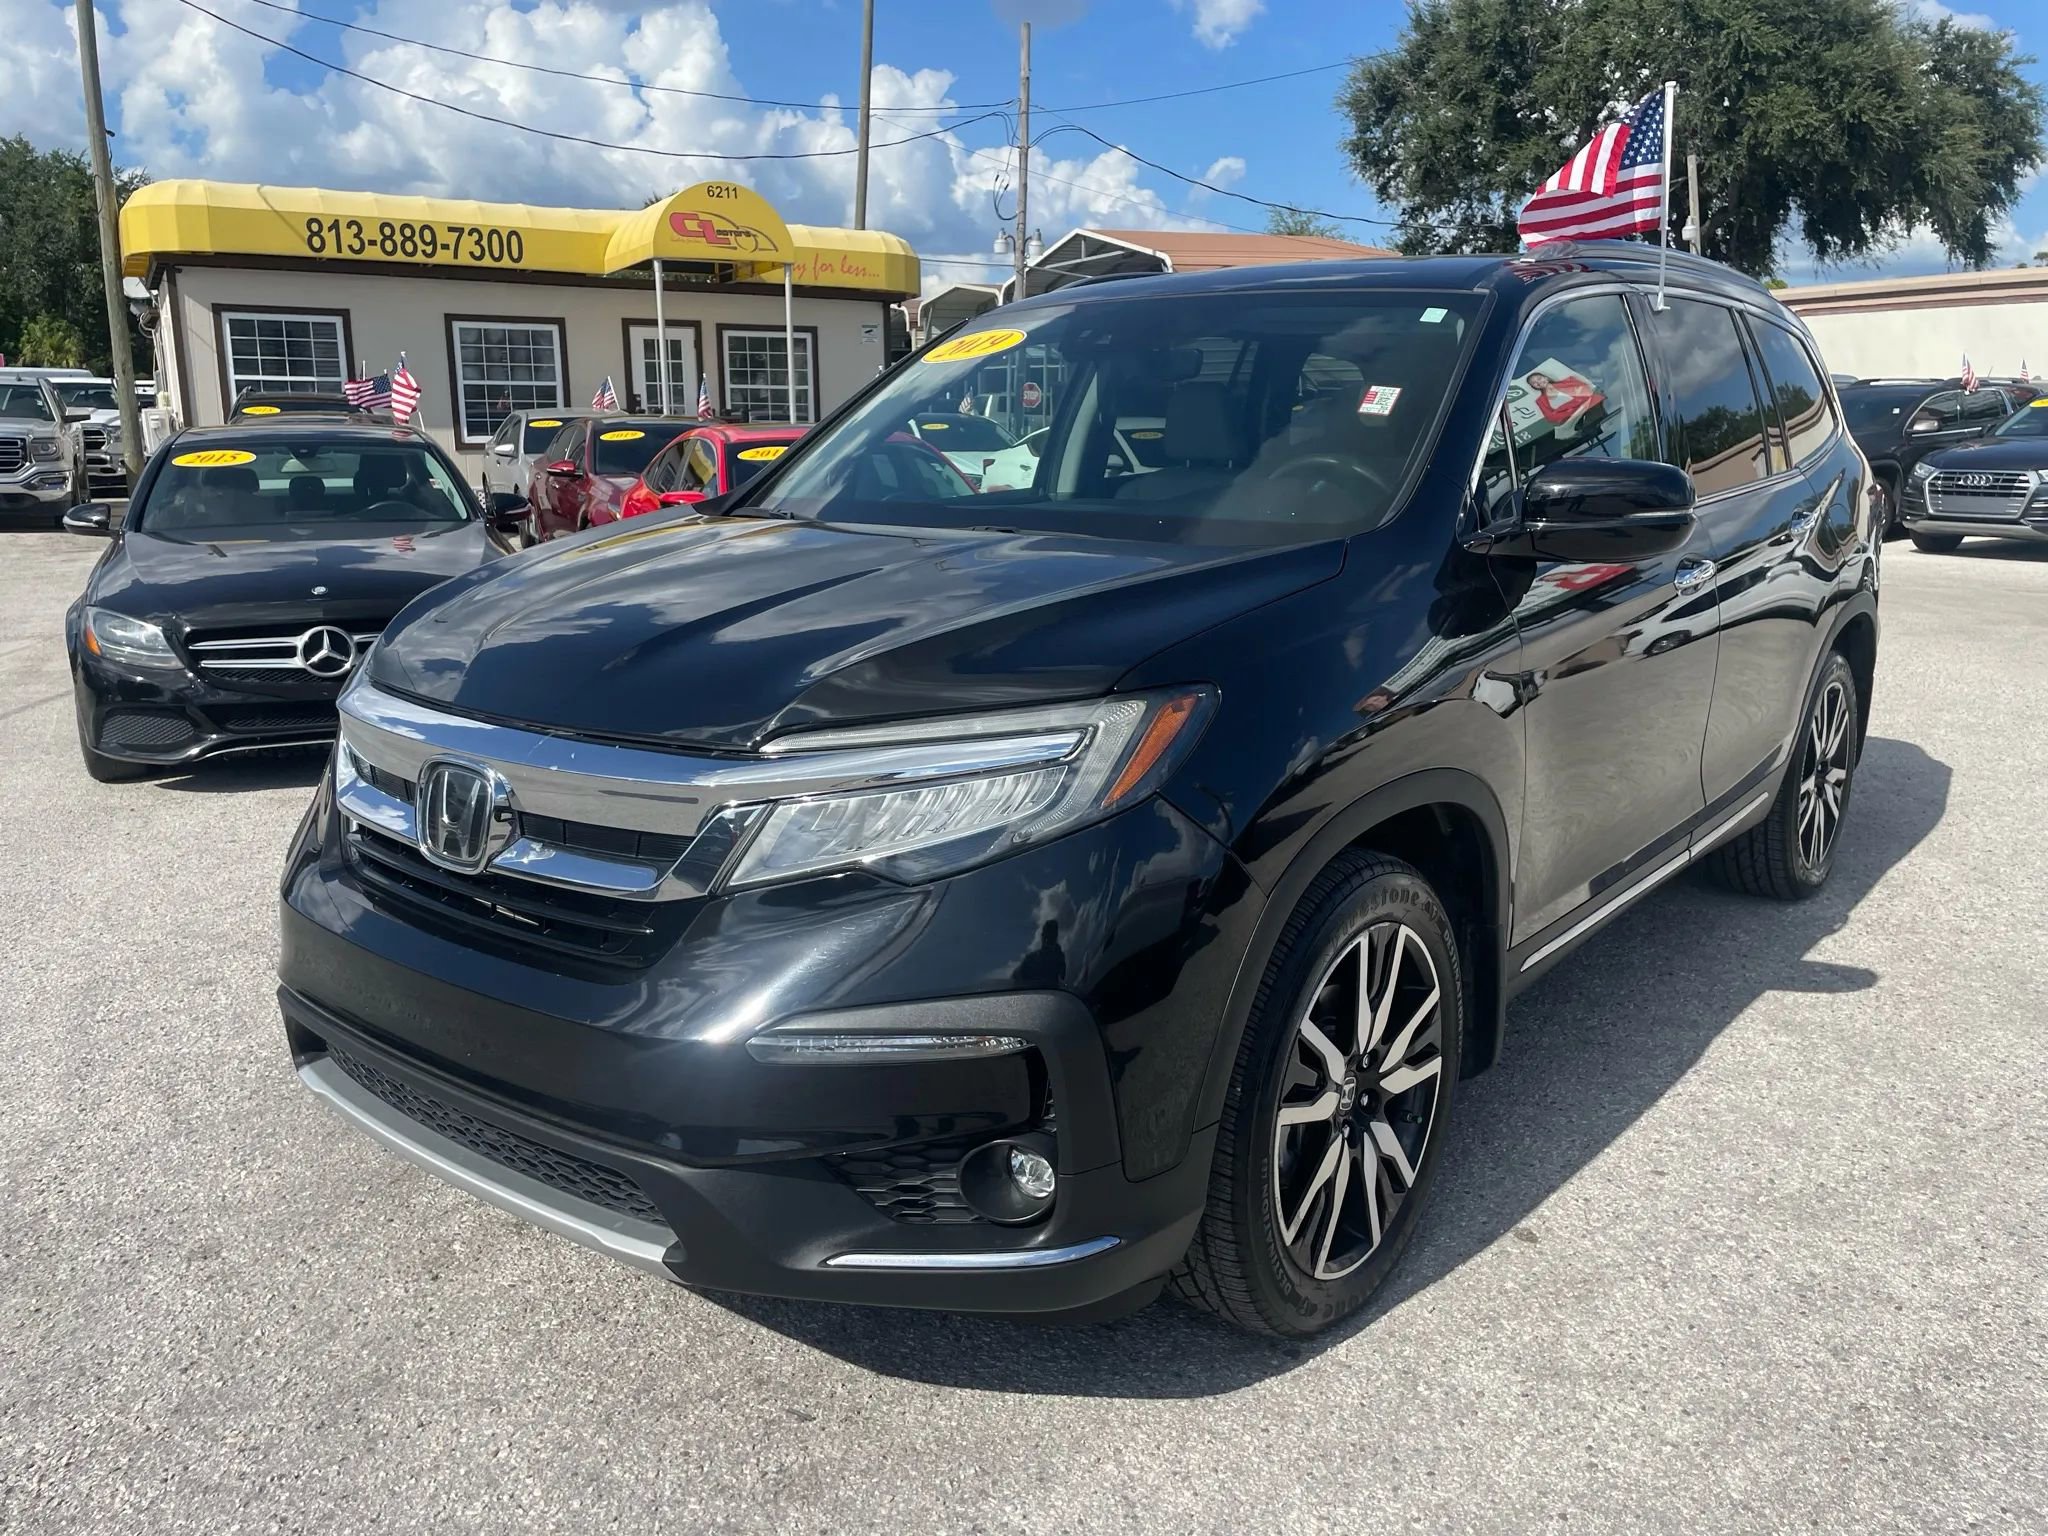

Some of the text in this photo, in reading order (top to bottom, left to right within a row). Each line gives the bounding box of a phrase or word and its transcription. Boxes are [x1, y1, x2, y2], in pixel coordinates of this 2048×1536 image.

[706, 185, 738, 199] 6211
[305, 217, 524, 264] 813-889-7300
[812, 253, 833, 280] for
[931, 332, 1015, 359] 2019
[1023, 390, 1039, 400] STOP
[186, 453, 242, 464] 2015
[751, 449, 781, 459] 201
[1261, 1183, 1293, 1296] DESTINATION
